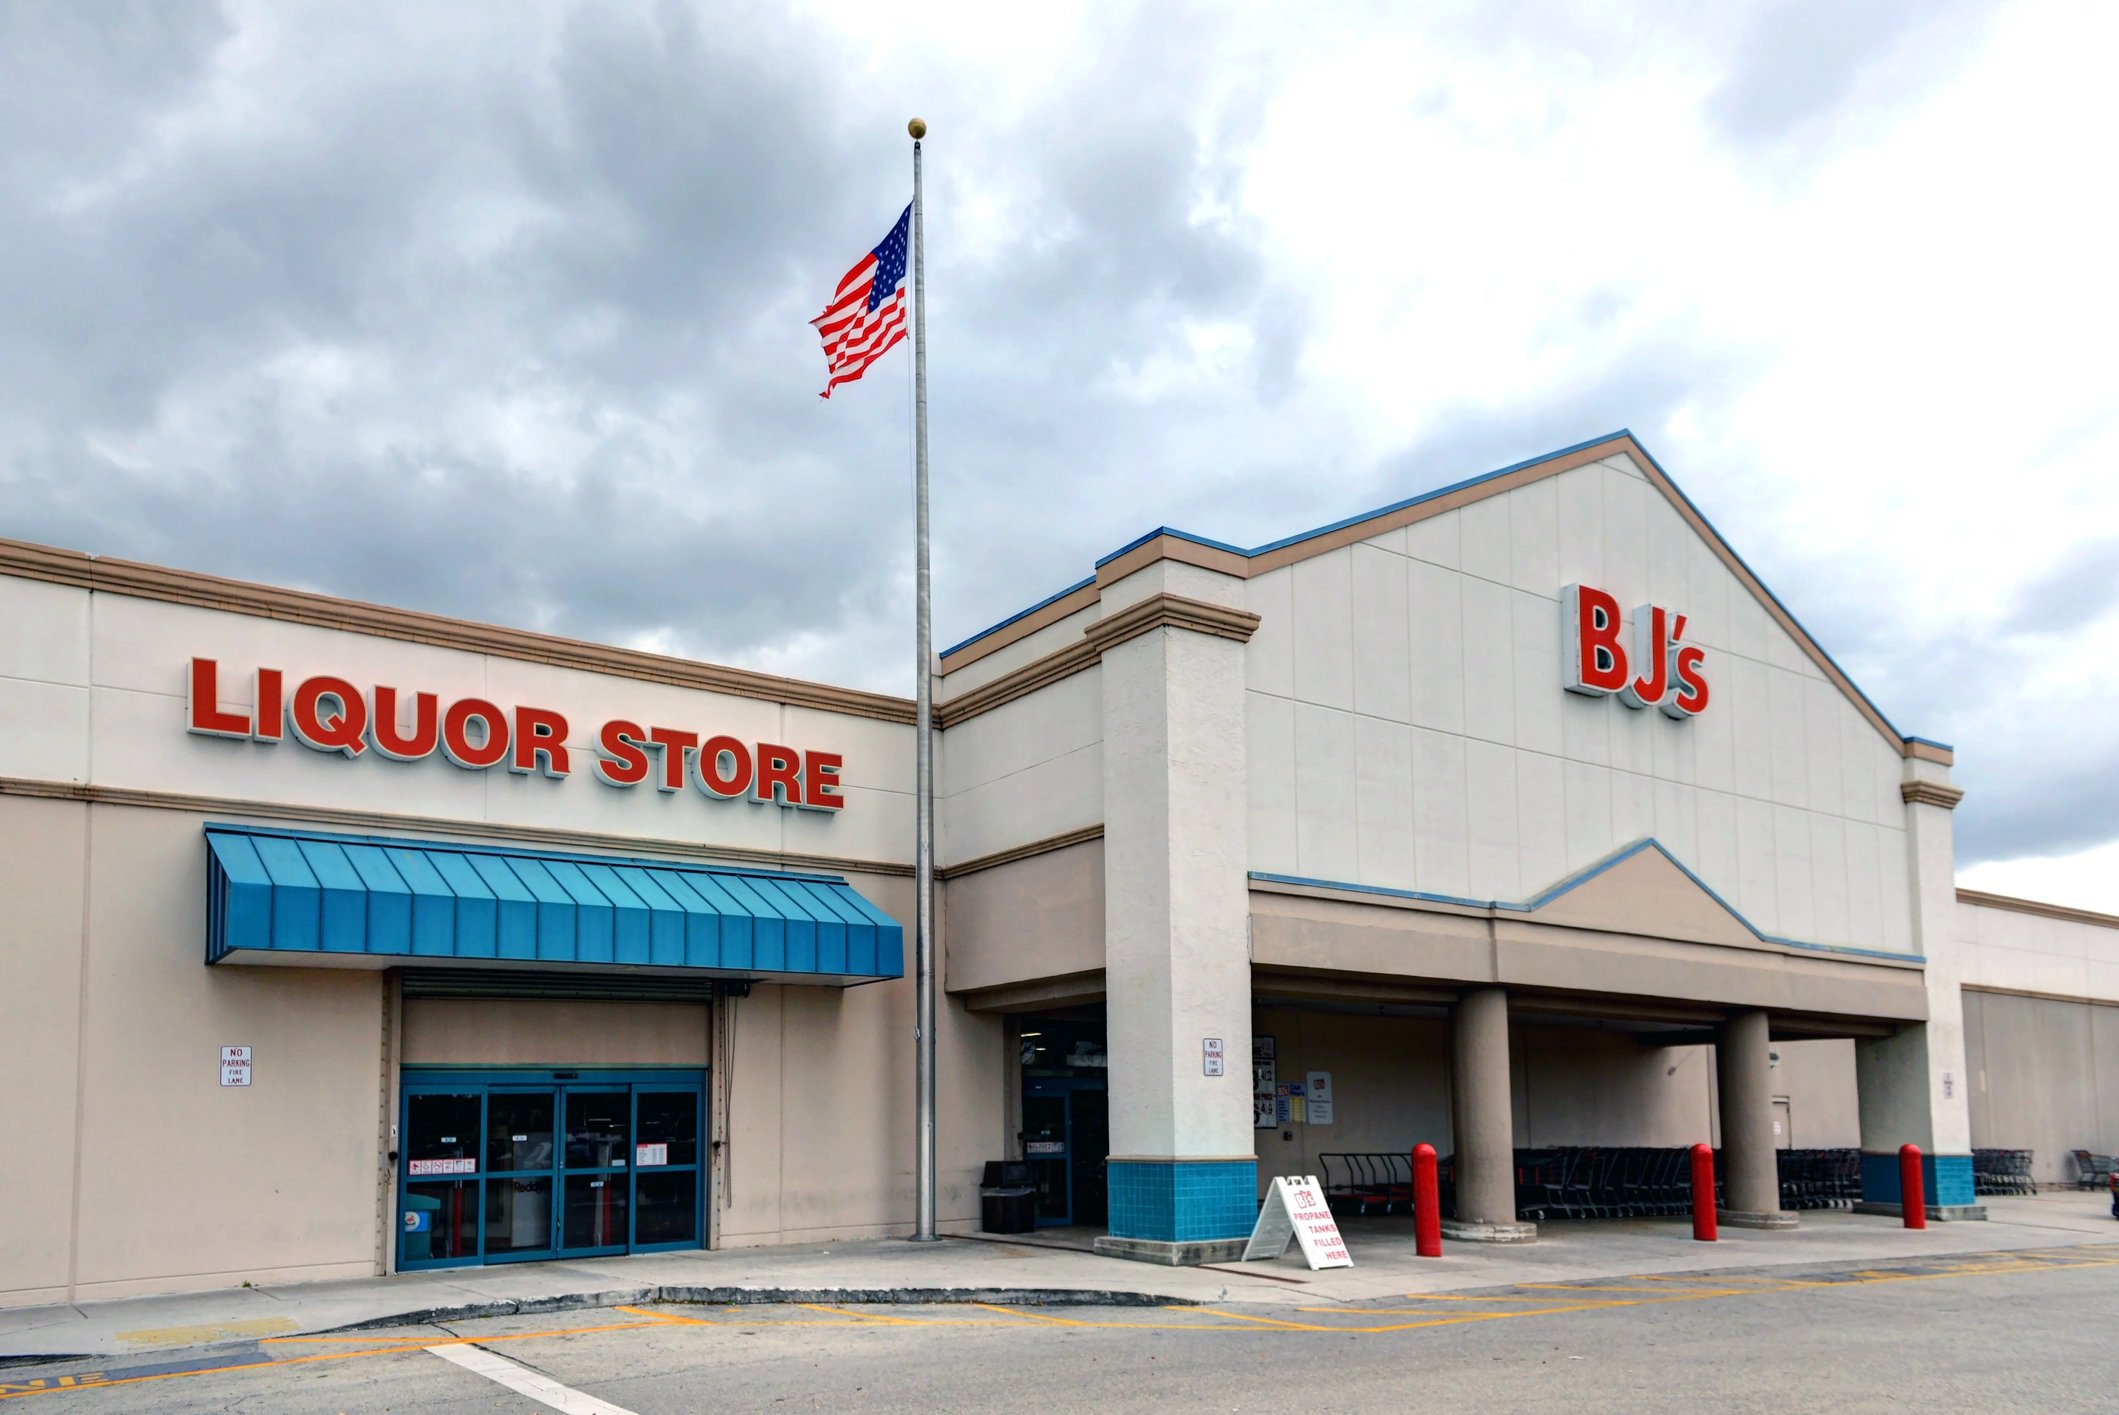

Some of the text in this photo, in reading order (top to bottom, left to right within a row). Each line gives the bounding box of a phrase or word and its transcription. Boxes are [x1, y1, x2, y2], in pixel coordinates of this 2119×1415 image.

[1576, 583, 1710, 715] BJ's
[189, 656, 845, 812] LIQUOR STORE
[1209, 1041, 1217, 1049] NO
[230, 1049, 243, 1057] NO
[222, 1059, 250, 1068] PARKING
[1293, 1210, 1331, 1221] PROPANE
[1308, 1223, 1337, 1234] TANKS
[1314, 1237, 1342, 1248] FILLED
[1325, 1250, 1349, 1260] HERE
